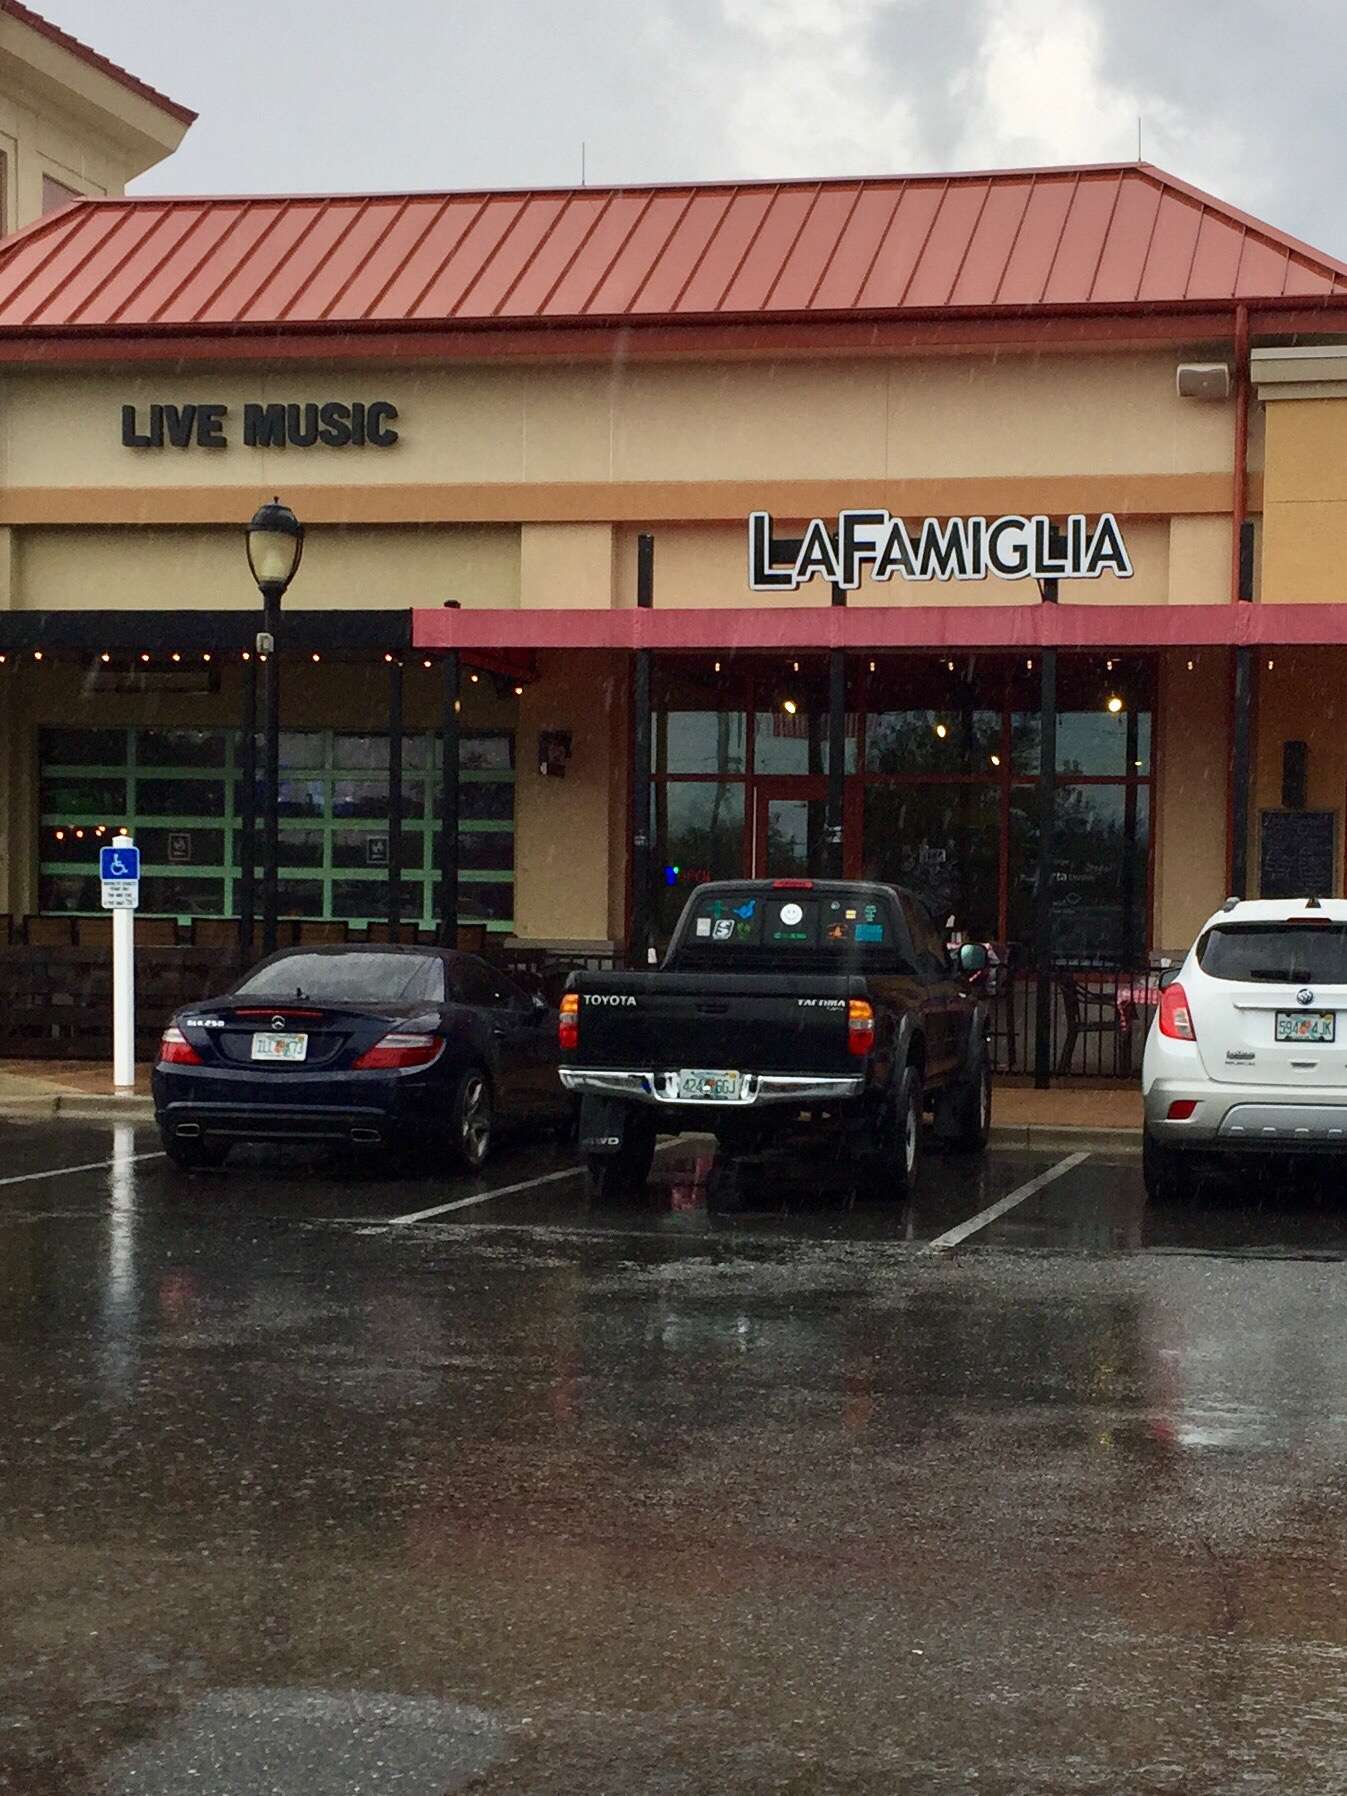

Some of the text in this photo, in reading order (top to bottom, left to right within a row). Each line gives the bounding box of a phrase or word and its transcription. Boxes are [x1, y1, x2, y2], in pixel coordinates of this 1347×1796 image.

[121, 401, 399, 447] LIVE MUSIC
[583, 994, 637, 1006] TOYOTA
